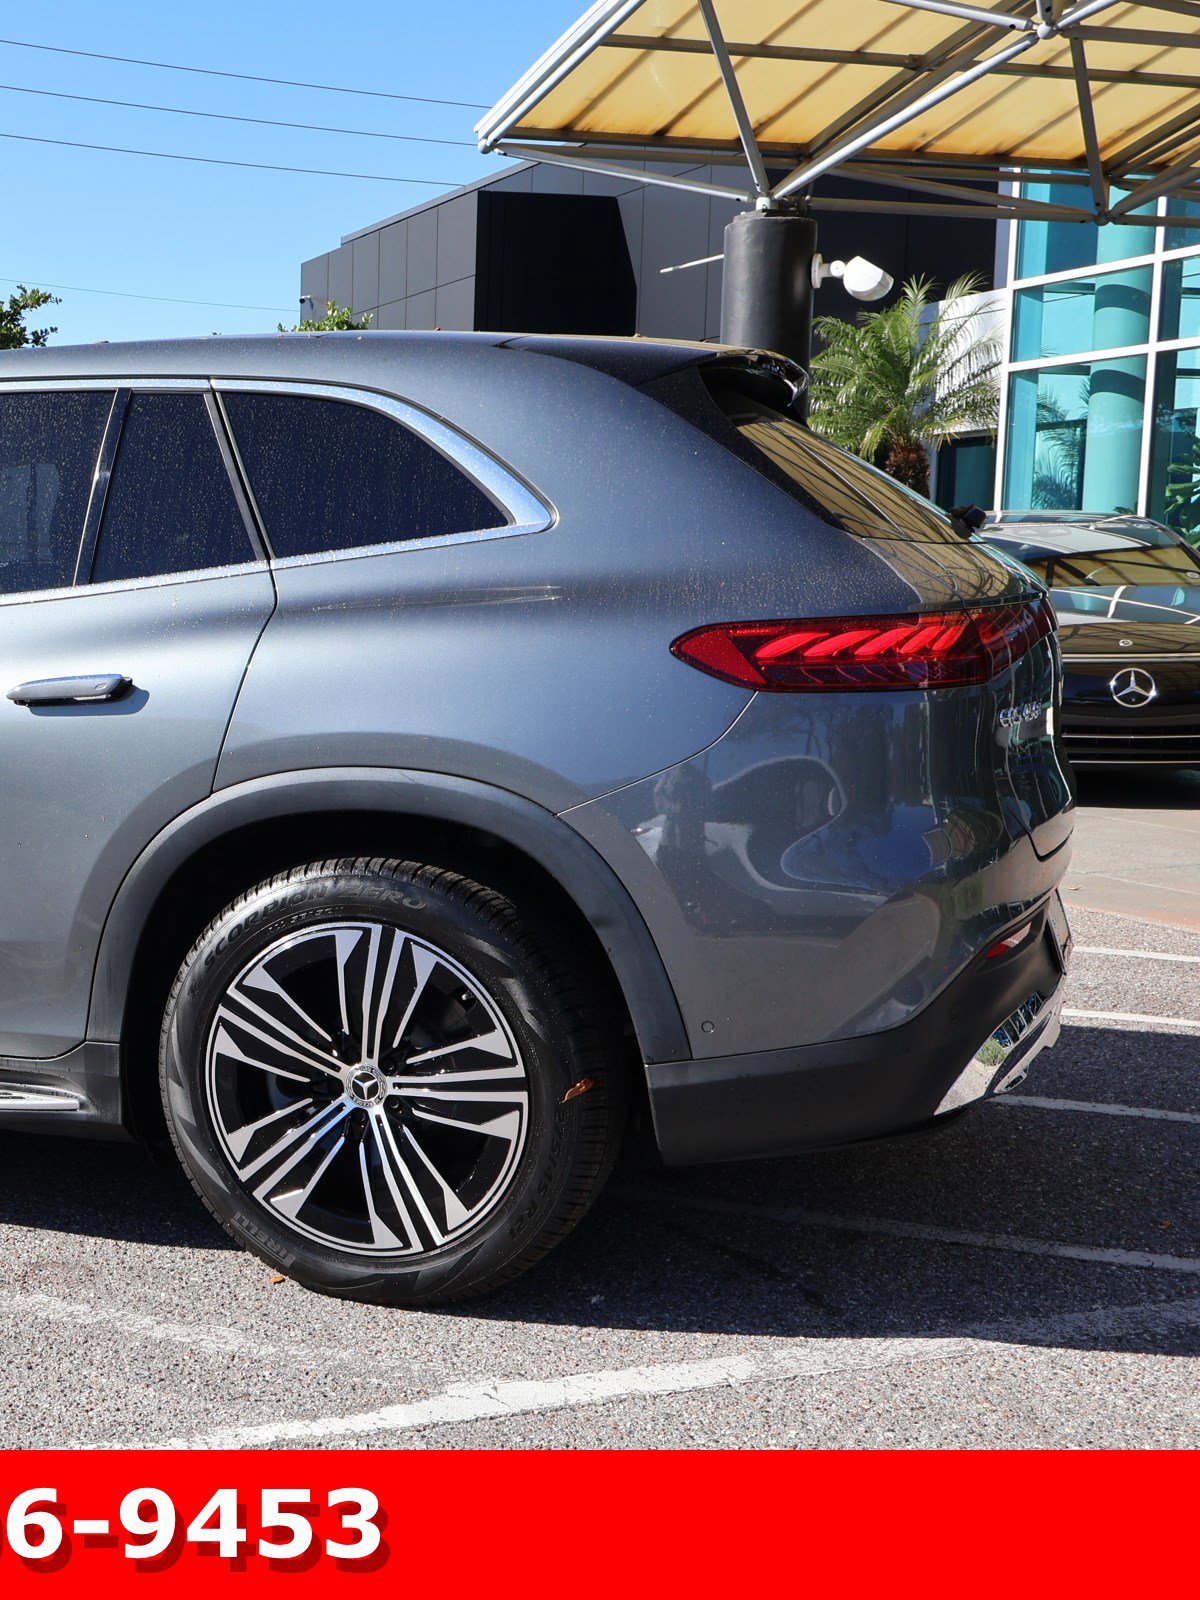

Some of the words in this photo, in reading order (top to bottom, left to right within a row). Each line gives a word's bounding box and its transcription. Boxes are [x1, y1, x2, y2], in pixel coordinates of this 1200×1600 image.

[204, 884, 328, 969] SCORPION
[338, 885, 429, 910] ZERO
[230, 1210, 297, 1268] PIRELLI
